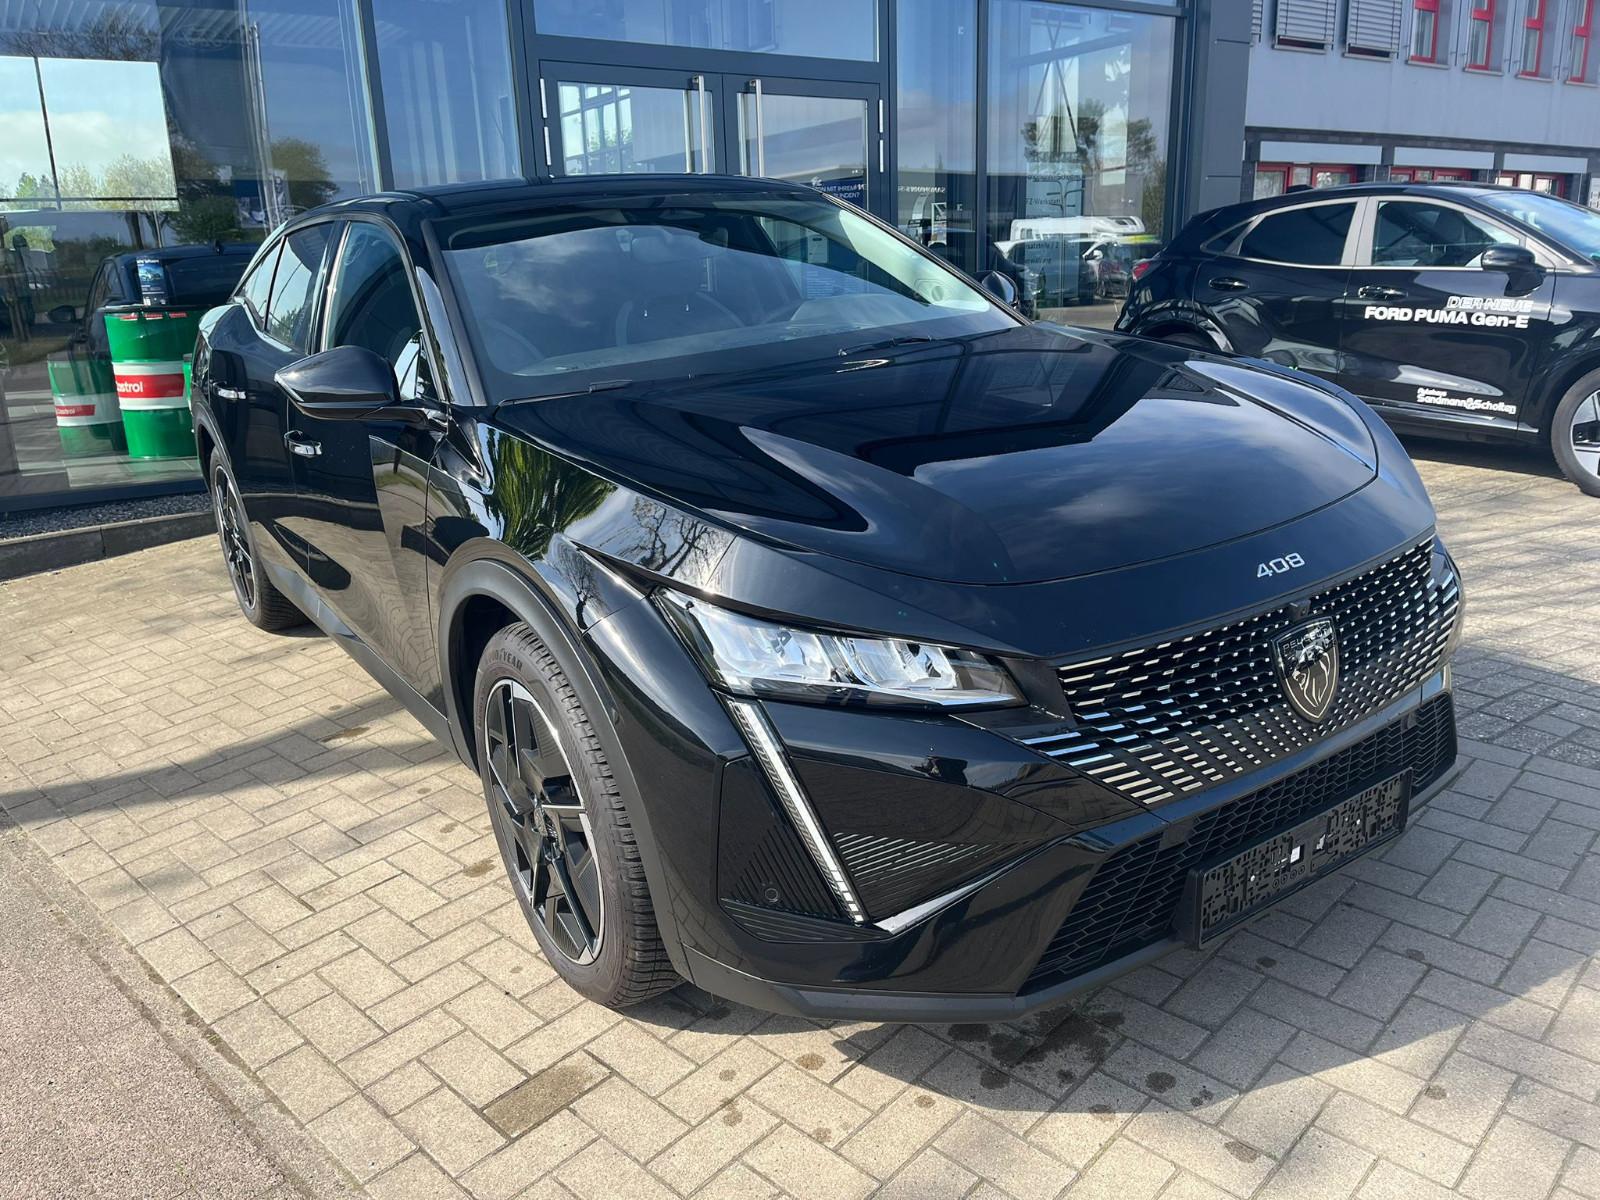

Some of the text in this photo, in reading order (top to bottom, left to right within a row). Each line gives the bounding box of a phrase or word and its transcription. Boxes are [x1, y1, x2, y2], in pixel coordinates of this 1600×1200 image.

[1447, 296, 1534, 313] DER NEUE
[1364, 306, 1529, 329] FORD PUMA Gen-E
[1256, 552, 1306, 578] 408
